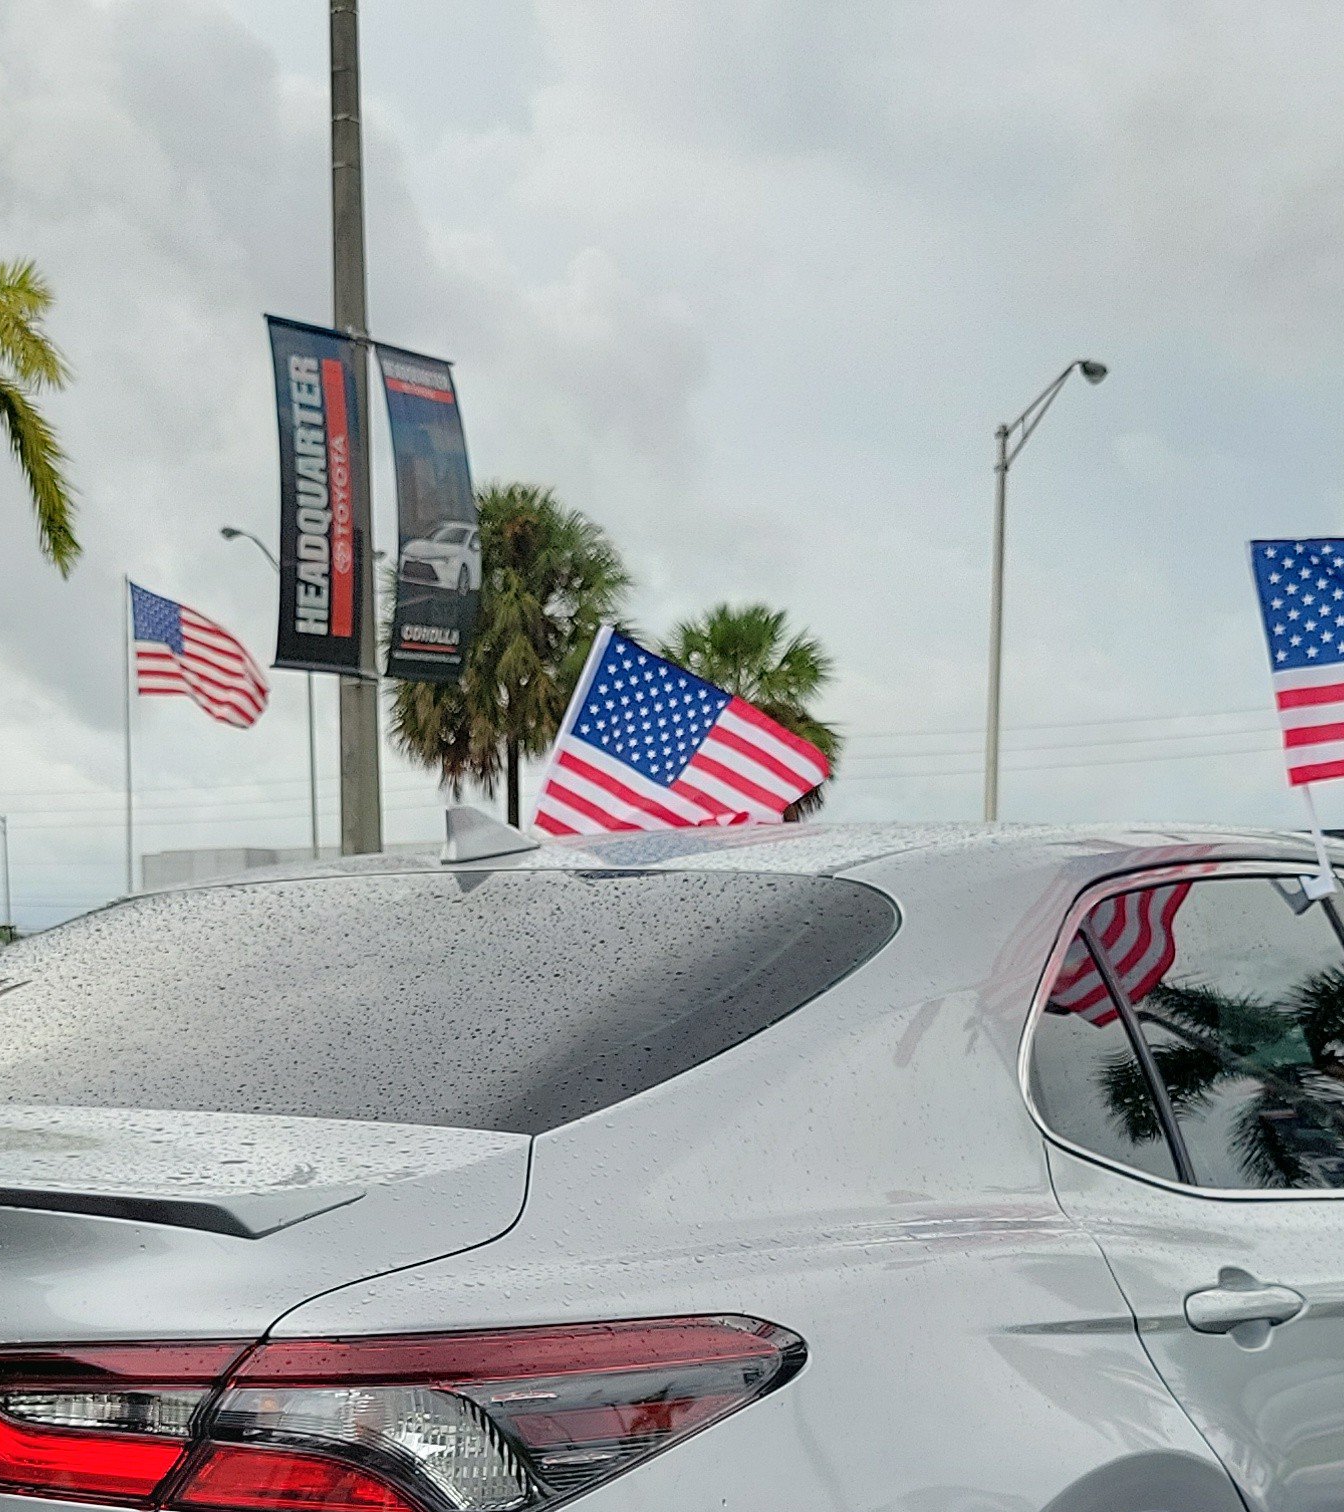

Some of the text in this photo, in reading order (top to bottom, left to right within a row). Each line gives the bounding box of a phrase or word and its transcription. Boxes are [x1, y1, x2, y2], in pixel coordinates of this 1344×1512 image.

[290, 356, 331, 636] HEADQUARTER
[333, 436, 352, 536] TOYOTA
[401, 625, 460, 646] COROLLA
